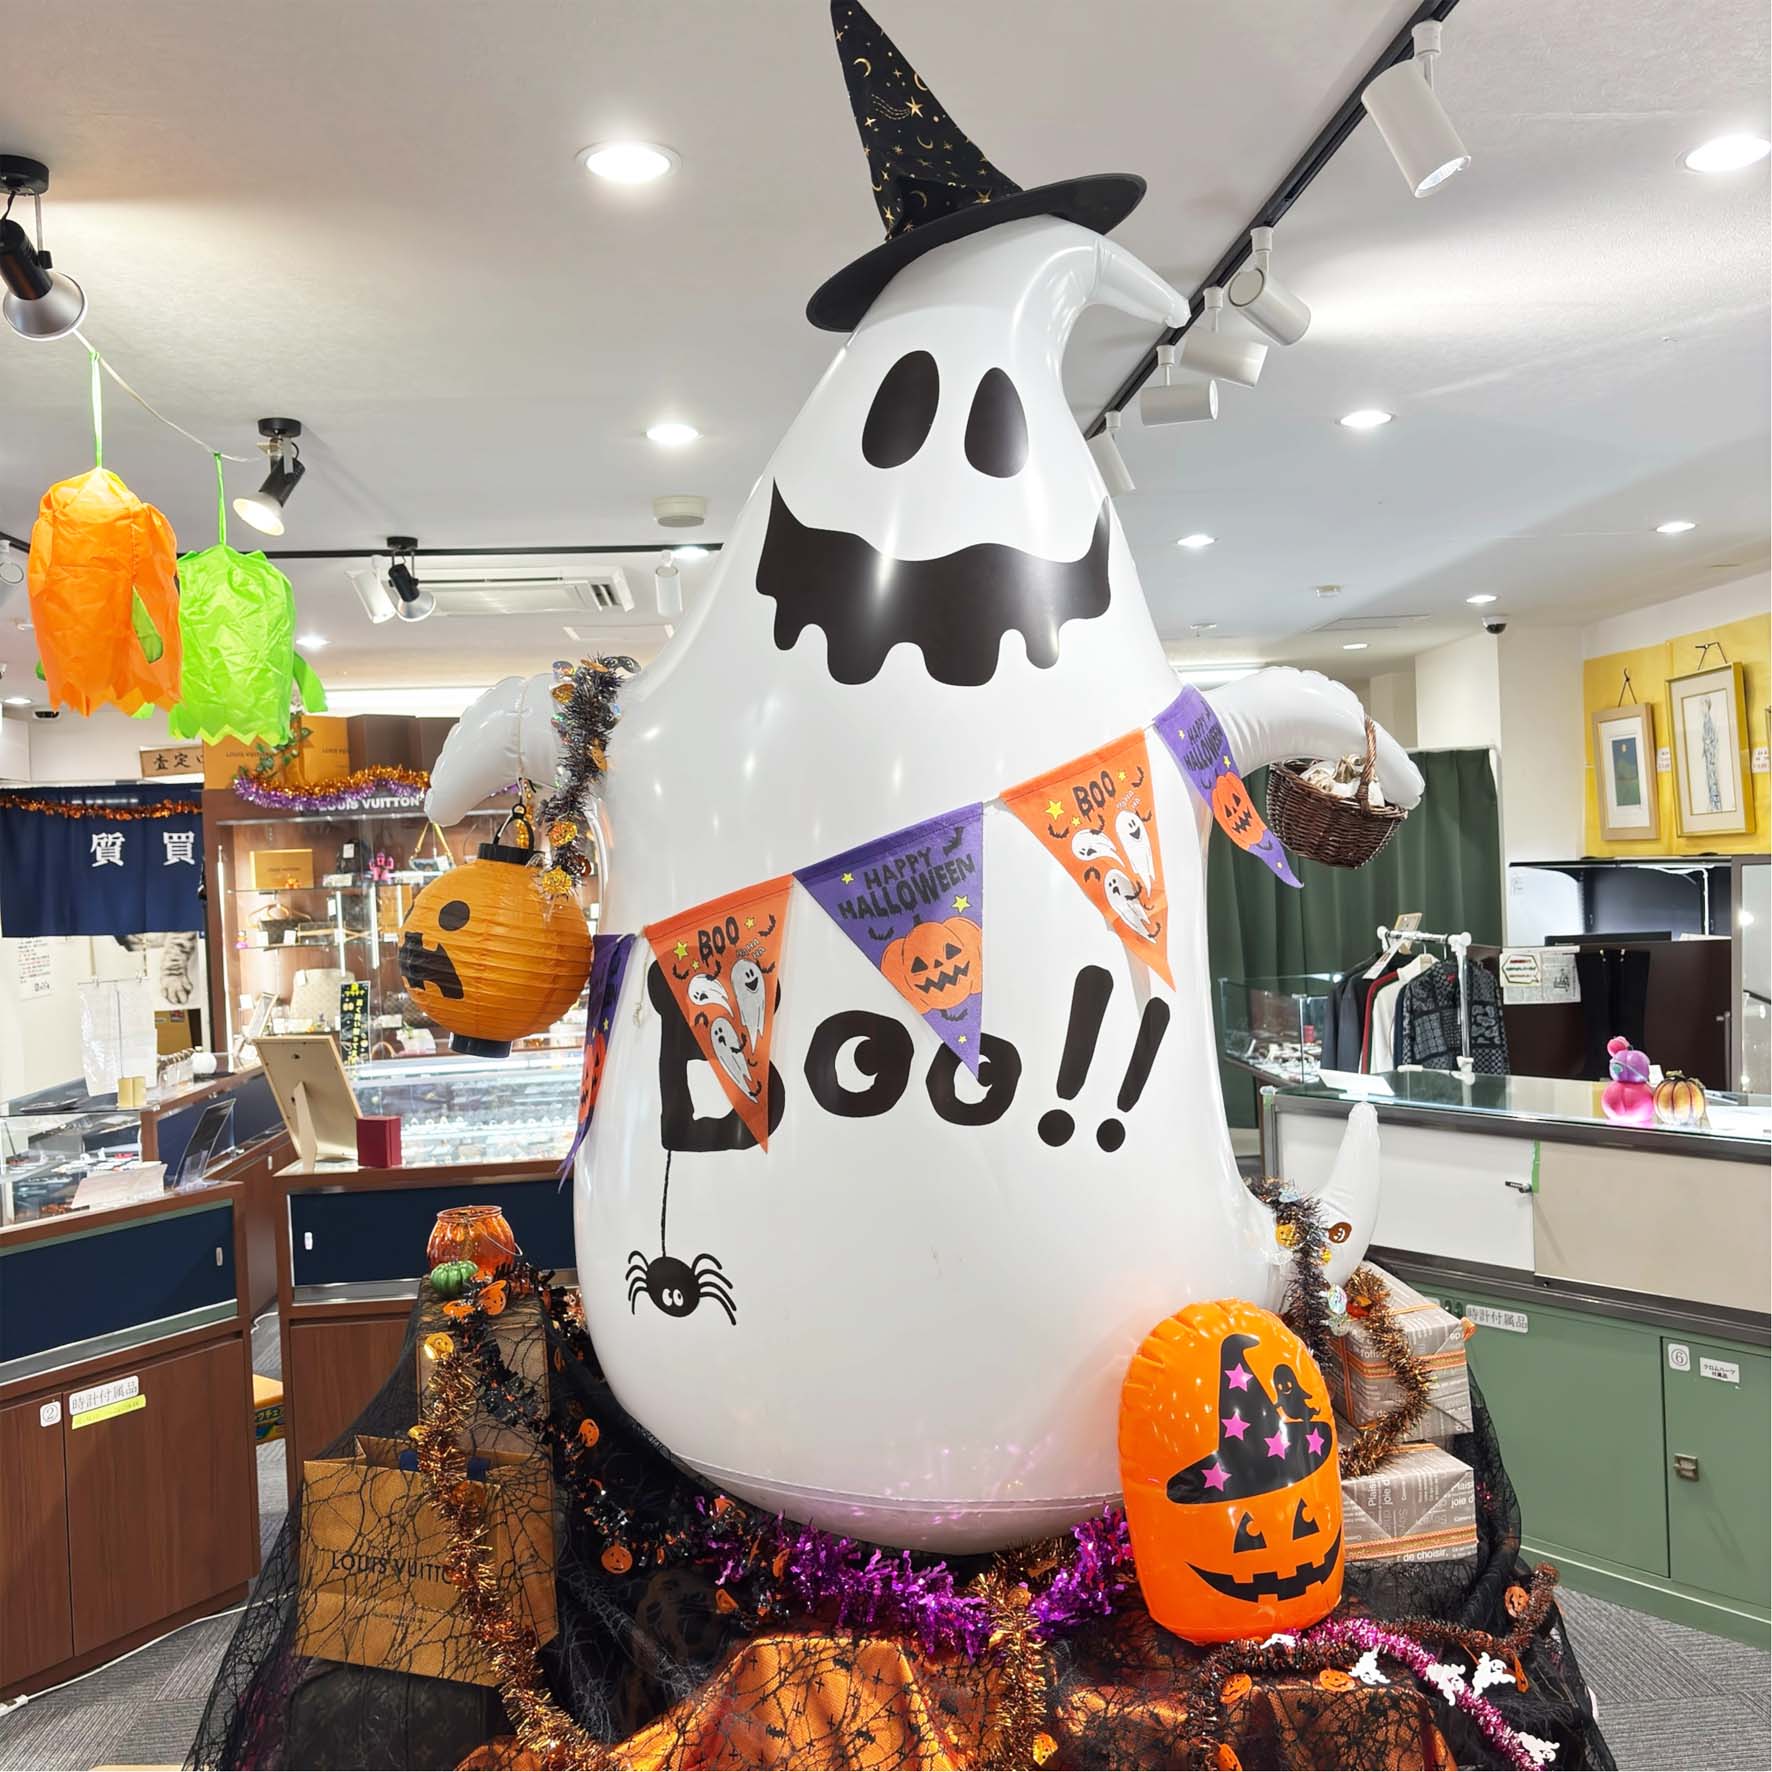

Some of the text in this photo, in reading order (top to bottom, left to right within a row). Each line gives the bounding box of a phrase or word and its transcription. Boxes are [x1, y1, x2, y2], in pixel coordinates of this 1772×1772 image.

[361, 797, 419, 809] VUITTON
[1072, 771, 1116, 821] BOO
[90, 831, 195, 867] 質 買
[863, 847, 932, 890] HAPPY
[837, 854, 976, 920] HALLOWEEN
[698, 916, 739, 967] BOO
[332, 1551, 387, 1574] LOUIS
